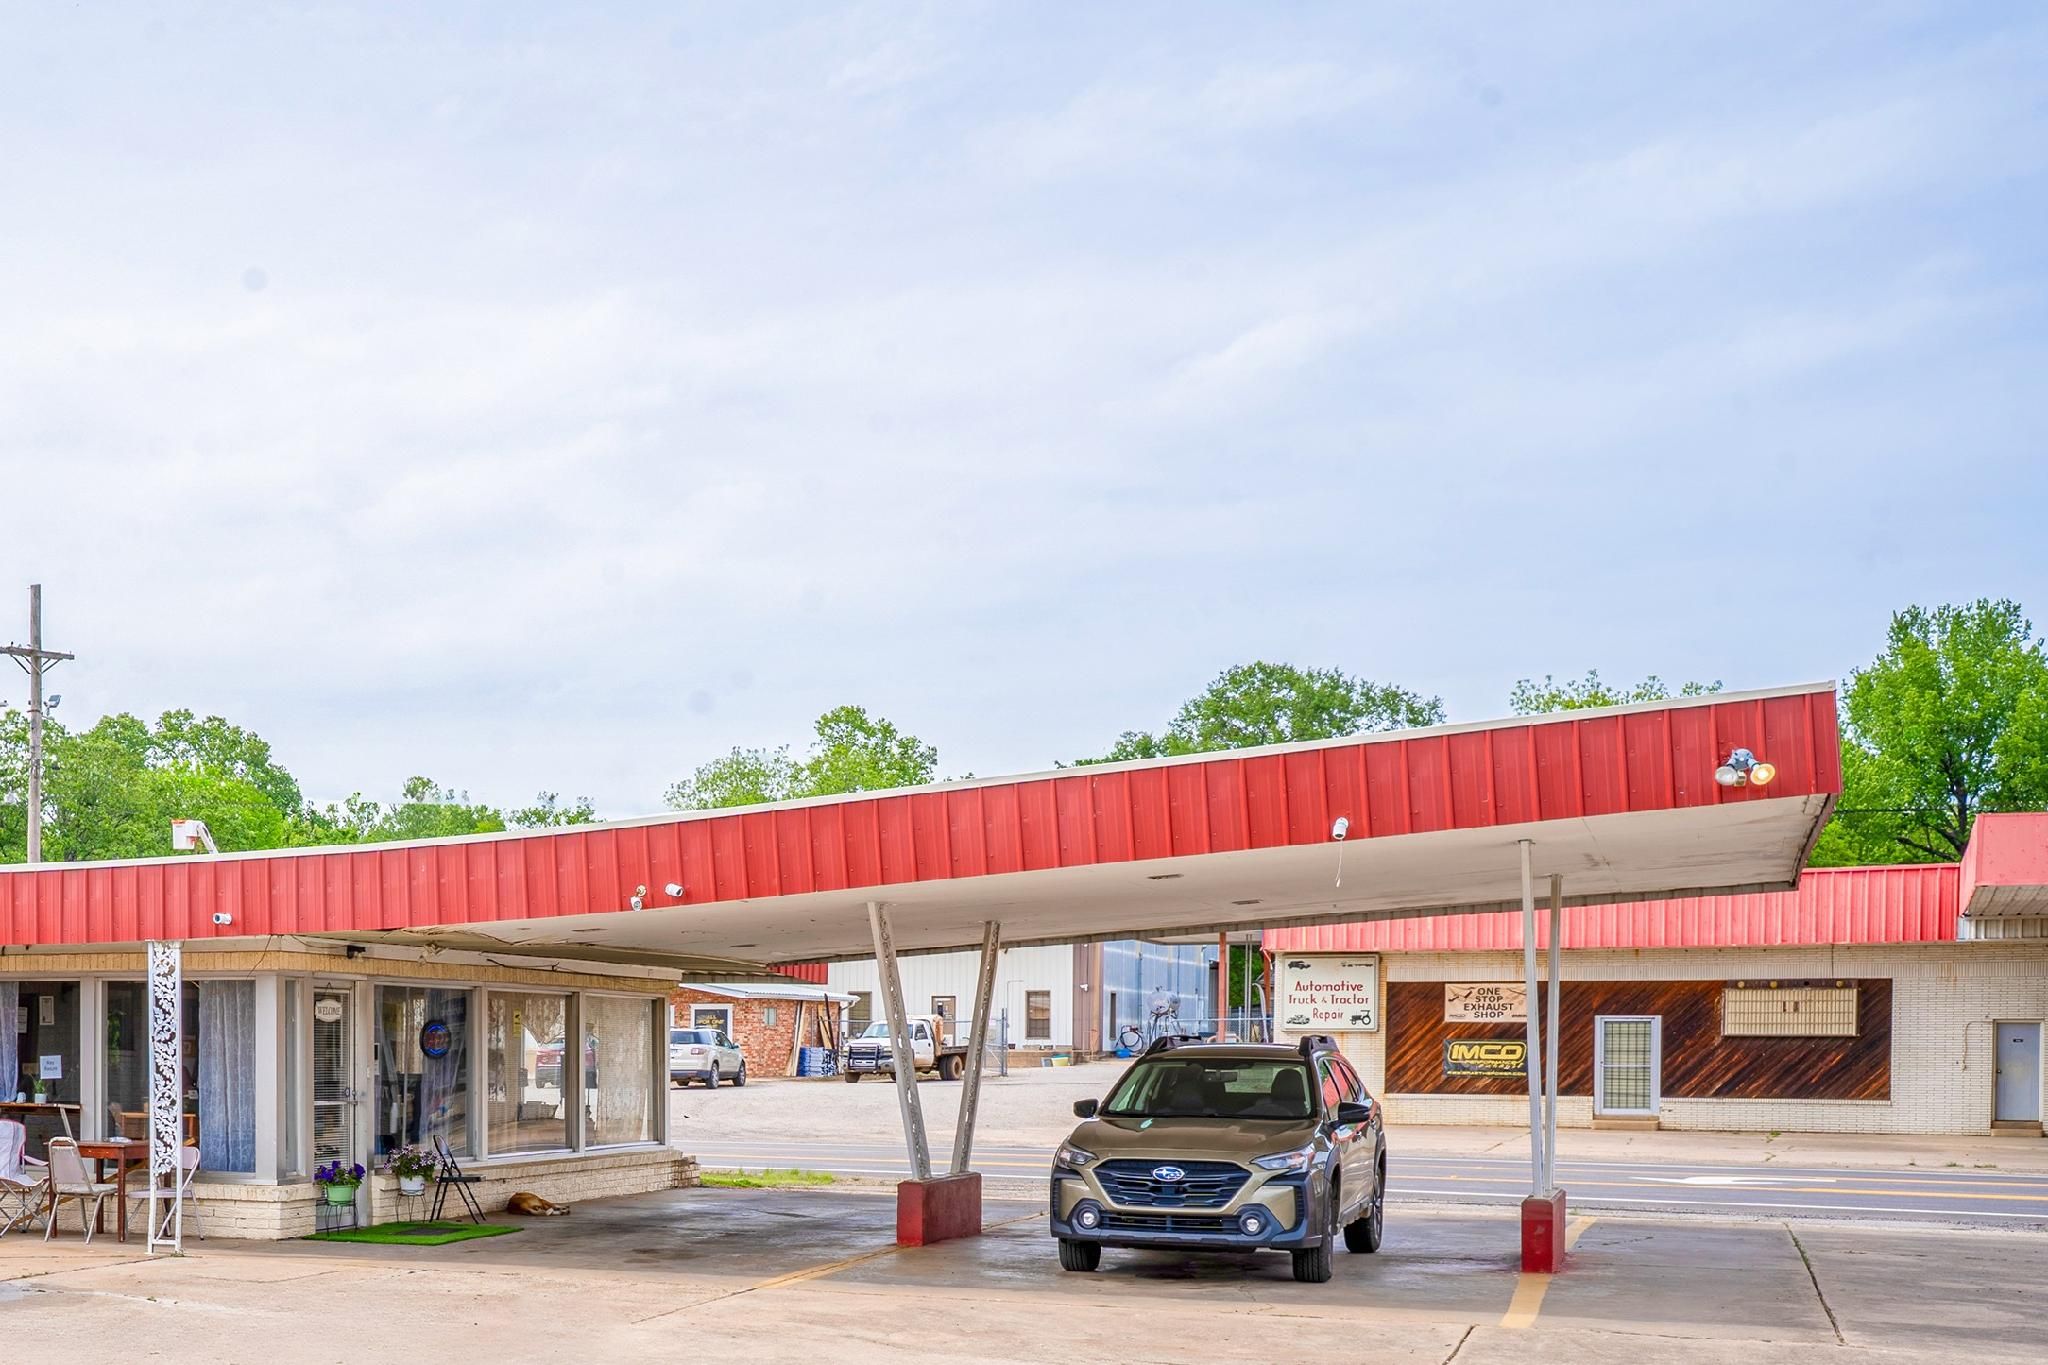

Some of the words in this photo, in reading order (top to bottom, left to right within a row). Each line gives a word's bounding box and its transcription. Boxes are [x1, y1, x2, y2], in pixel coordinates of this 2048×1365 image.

[1295, 980, 1364, 992] Automotive
[1477, 987, 1501, 996] ONE
[1288, 994, 1317, 1004] Truck
[1330, 993, 1369, 1005] Tractor
[1475, 995, 1504, 1003] STOP
[1463, 1002, 1514, 1011] EXHAUST
[1312, 1007, 1344, 1022] Repair
[1451, 1045, 1523, 1059] IMCO
